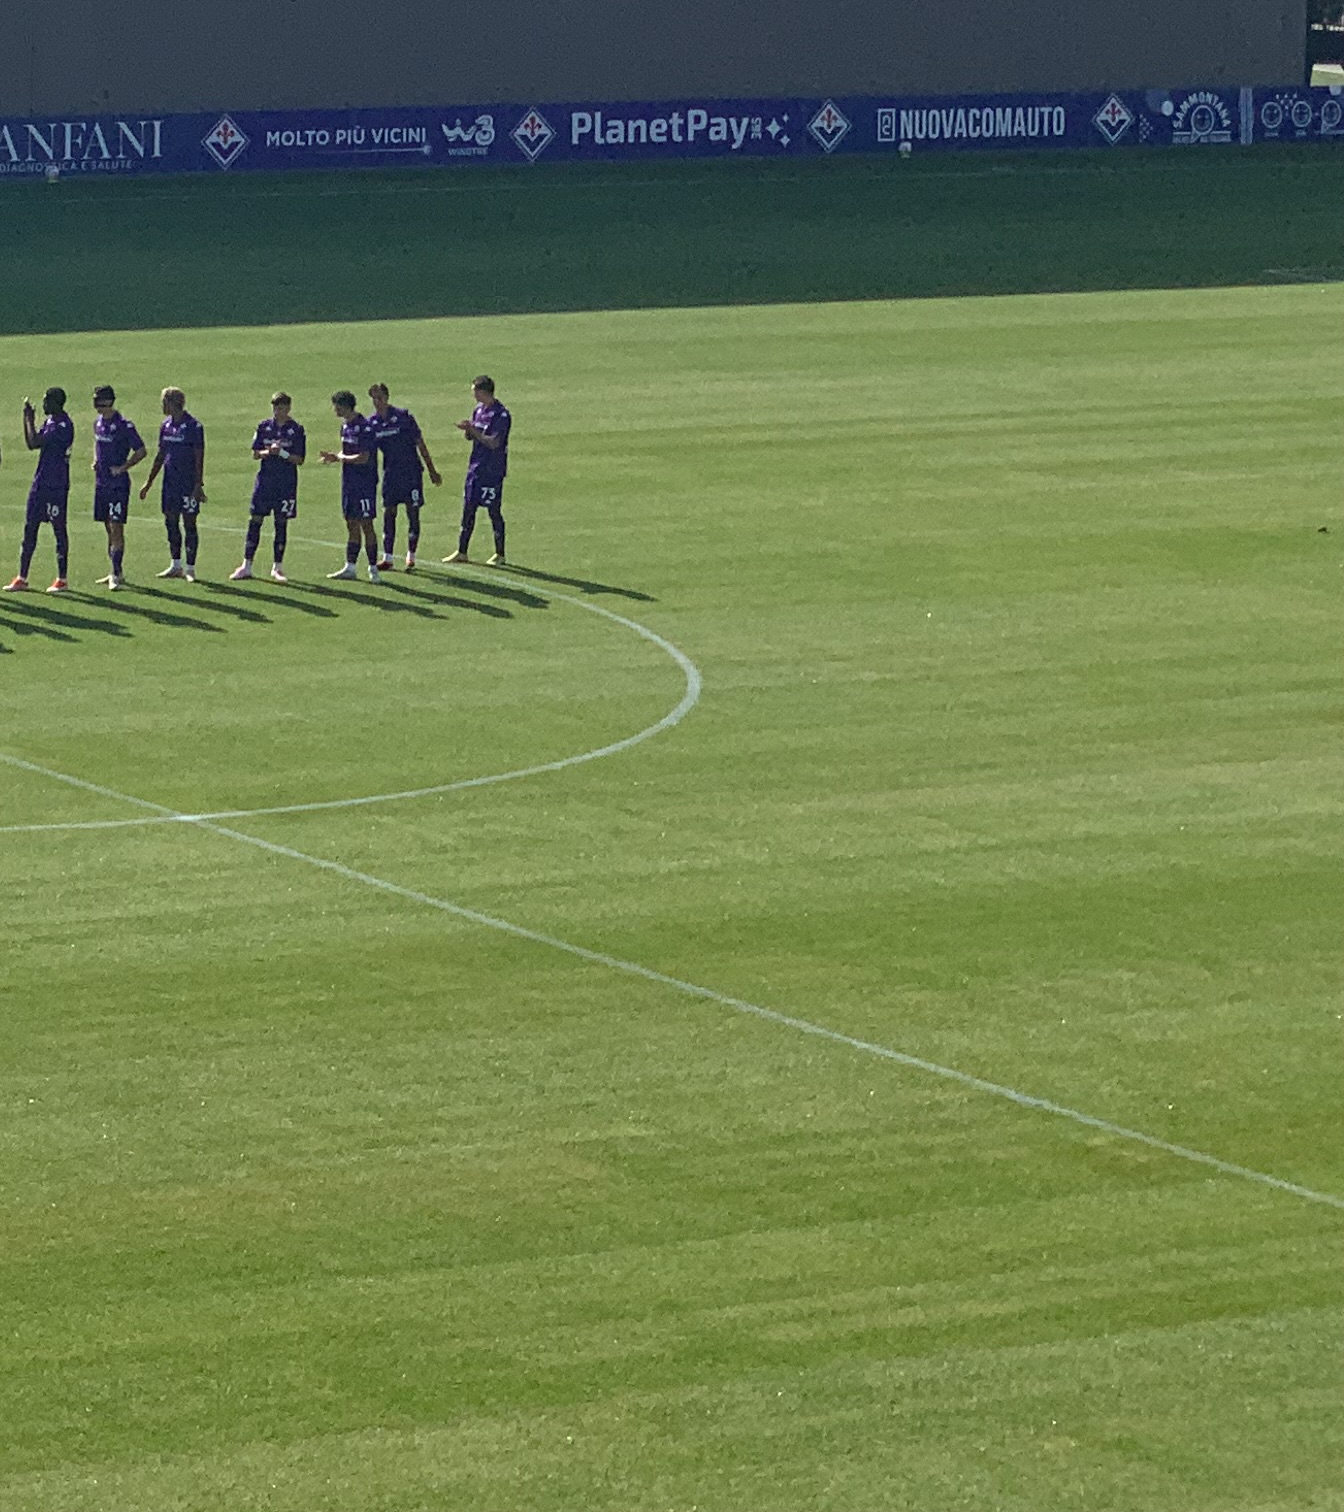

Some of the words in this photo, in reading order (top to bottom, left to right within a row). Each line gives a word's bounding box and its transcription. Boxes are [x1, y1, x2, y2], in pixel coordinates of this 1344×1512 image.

[900, 106, 1066, 141] NUOVACOMAUTO
[1172, 91, 1232, 129] SAMMONTANA
[266, 130, 330, 147] MOLTO
[335, 125, 365, 146] PIÙ
[372, 127, 426, 144] VICINI
[571, 109, 750, 149] PlanetPay
[91, 159, 133, 170] SALUTE
